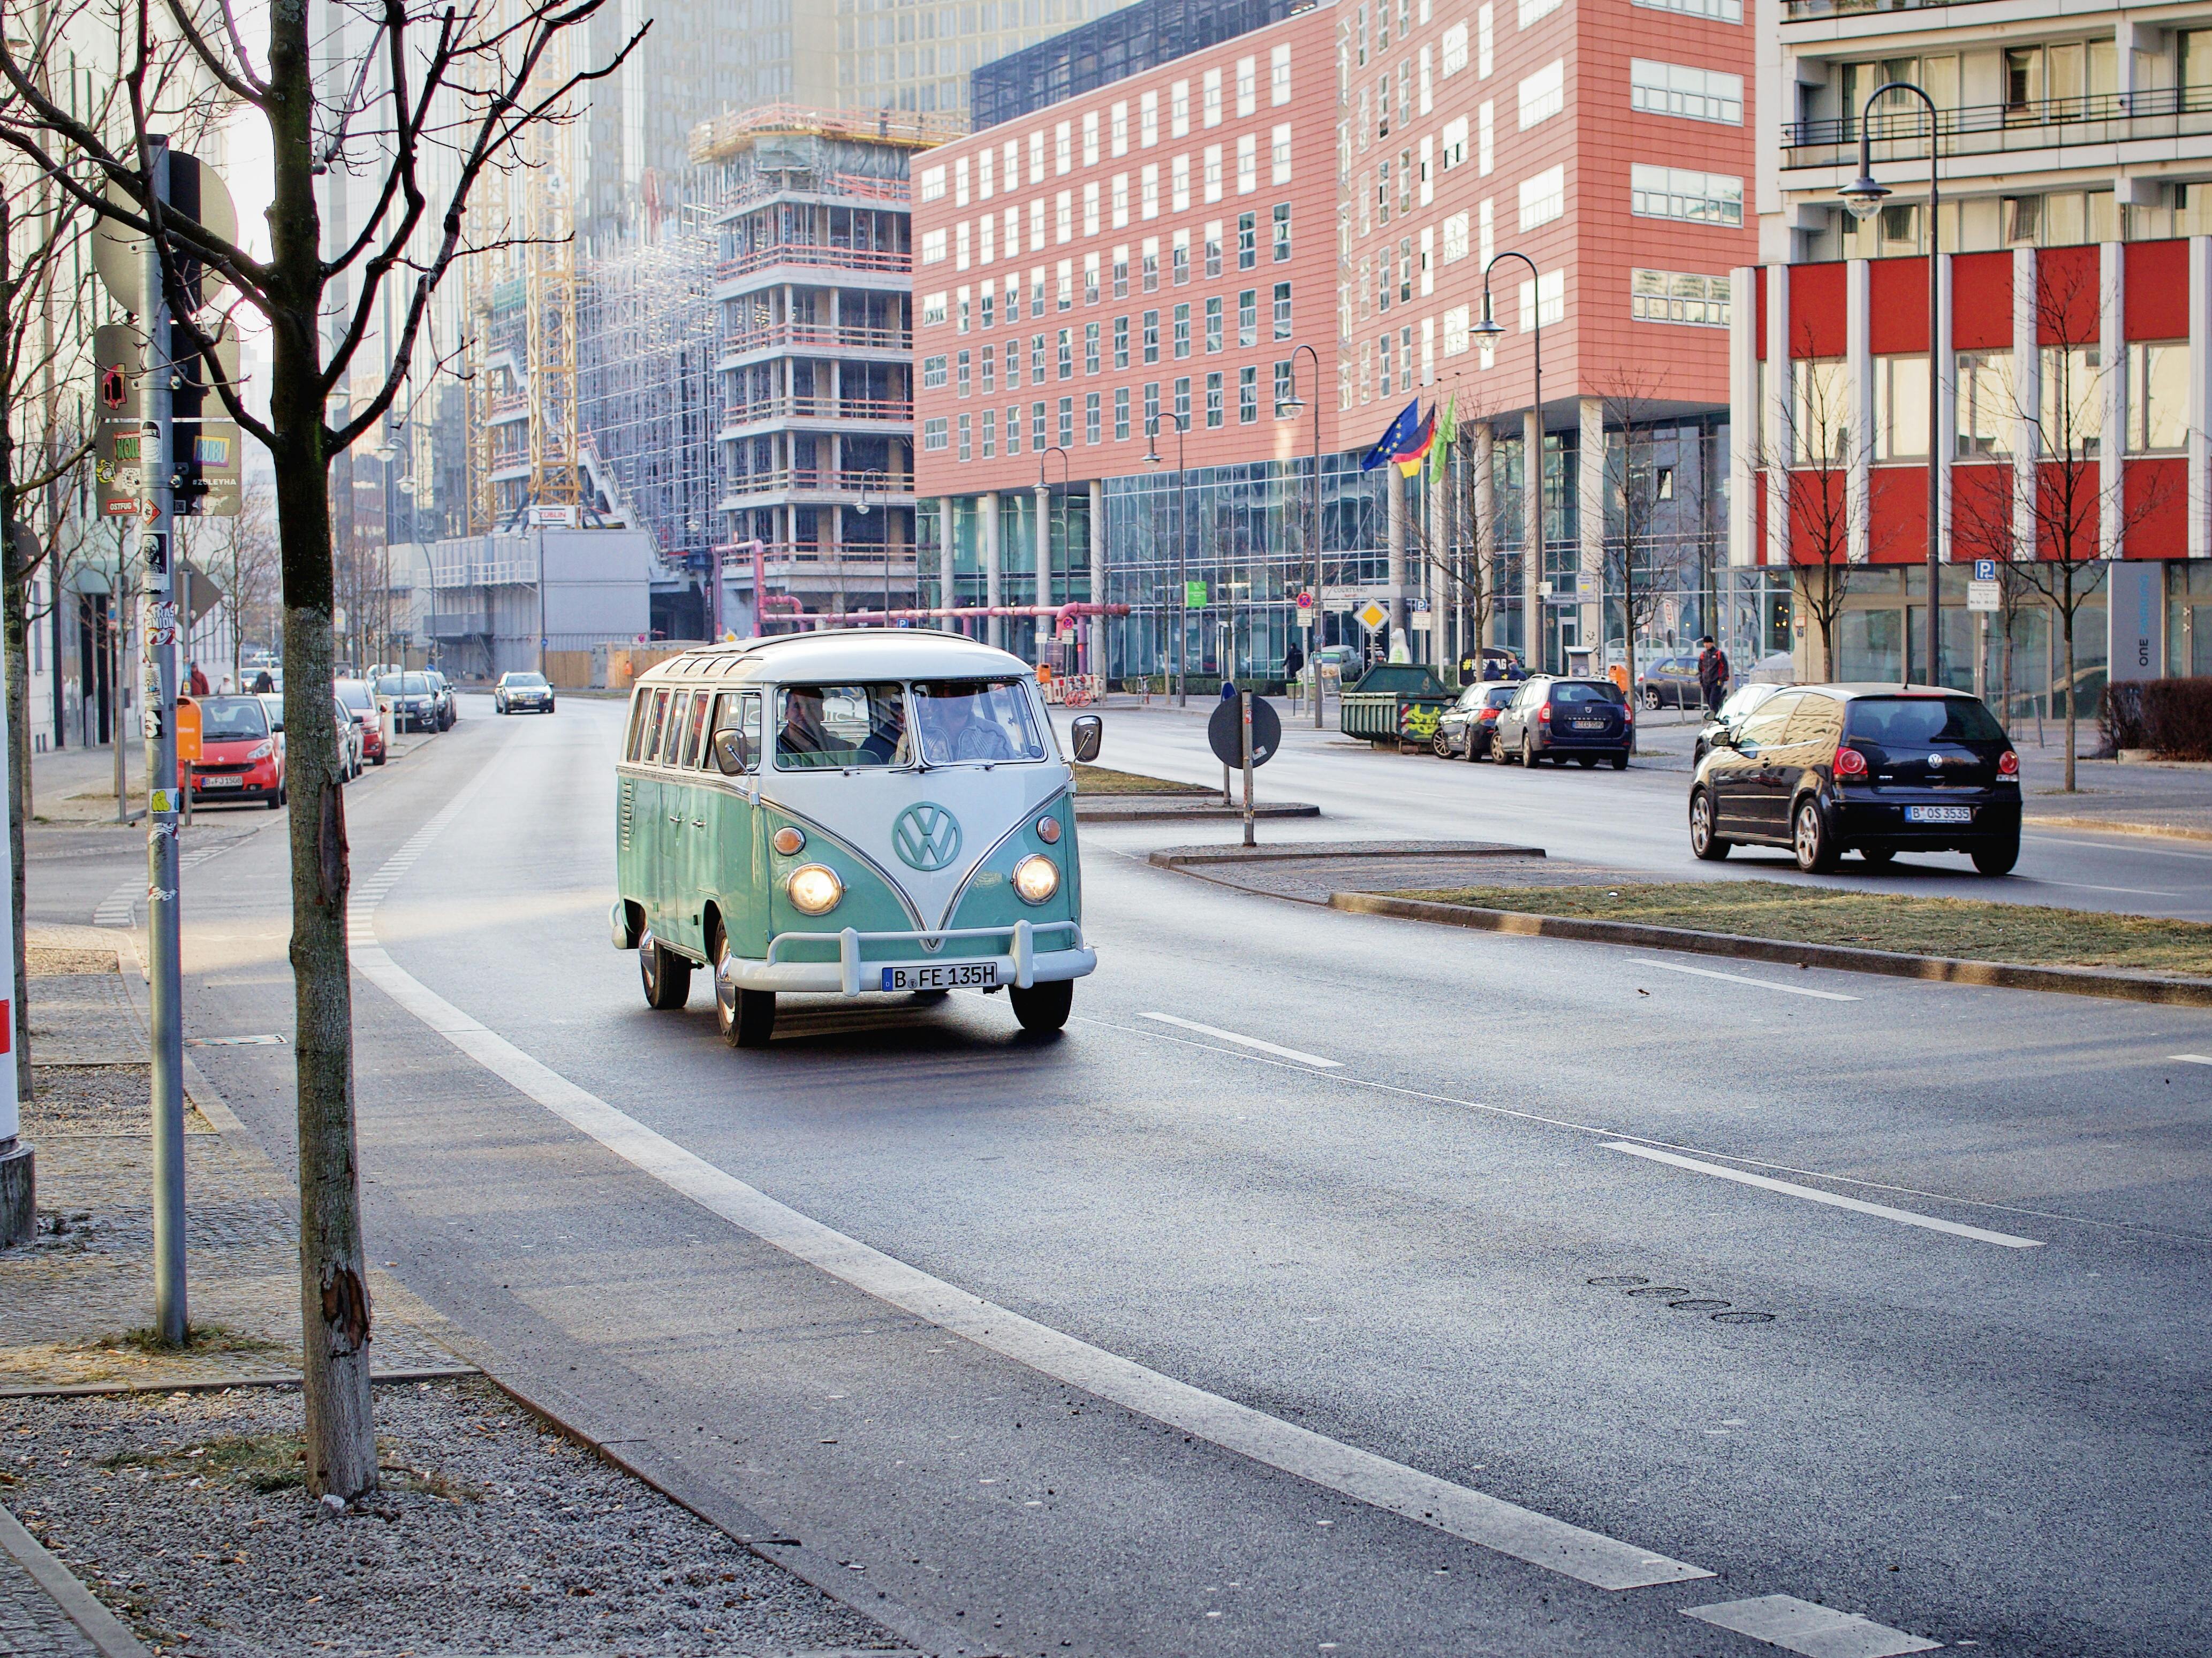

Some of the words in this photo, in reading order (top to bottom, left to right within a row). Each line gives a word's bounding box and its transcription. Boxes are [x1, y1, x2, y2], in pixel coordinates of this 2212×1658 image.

[552, 177, 559, 189] 4
[1980, 562, 1991, 578] P
[1913, 808, 1920, 818] B
[1927, 808, 1941, 818] OS
[1944, 808, 1969, 819] 3535
[891, 801, 963, 871] VW
[895, 970, 906, 988] B
[919, 969, 943, 987] FE
[948, 965, 995, 985] 135H
